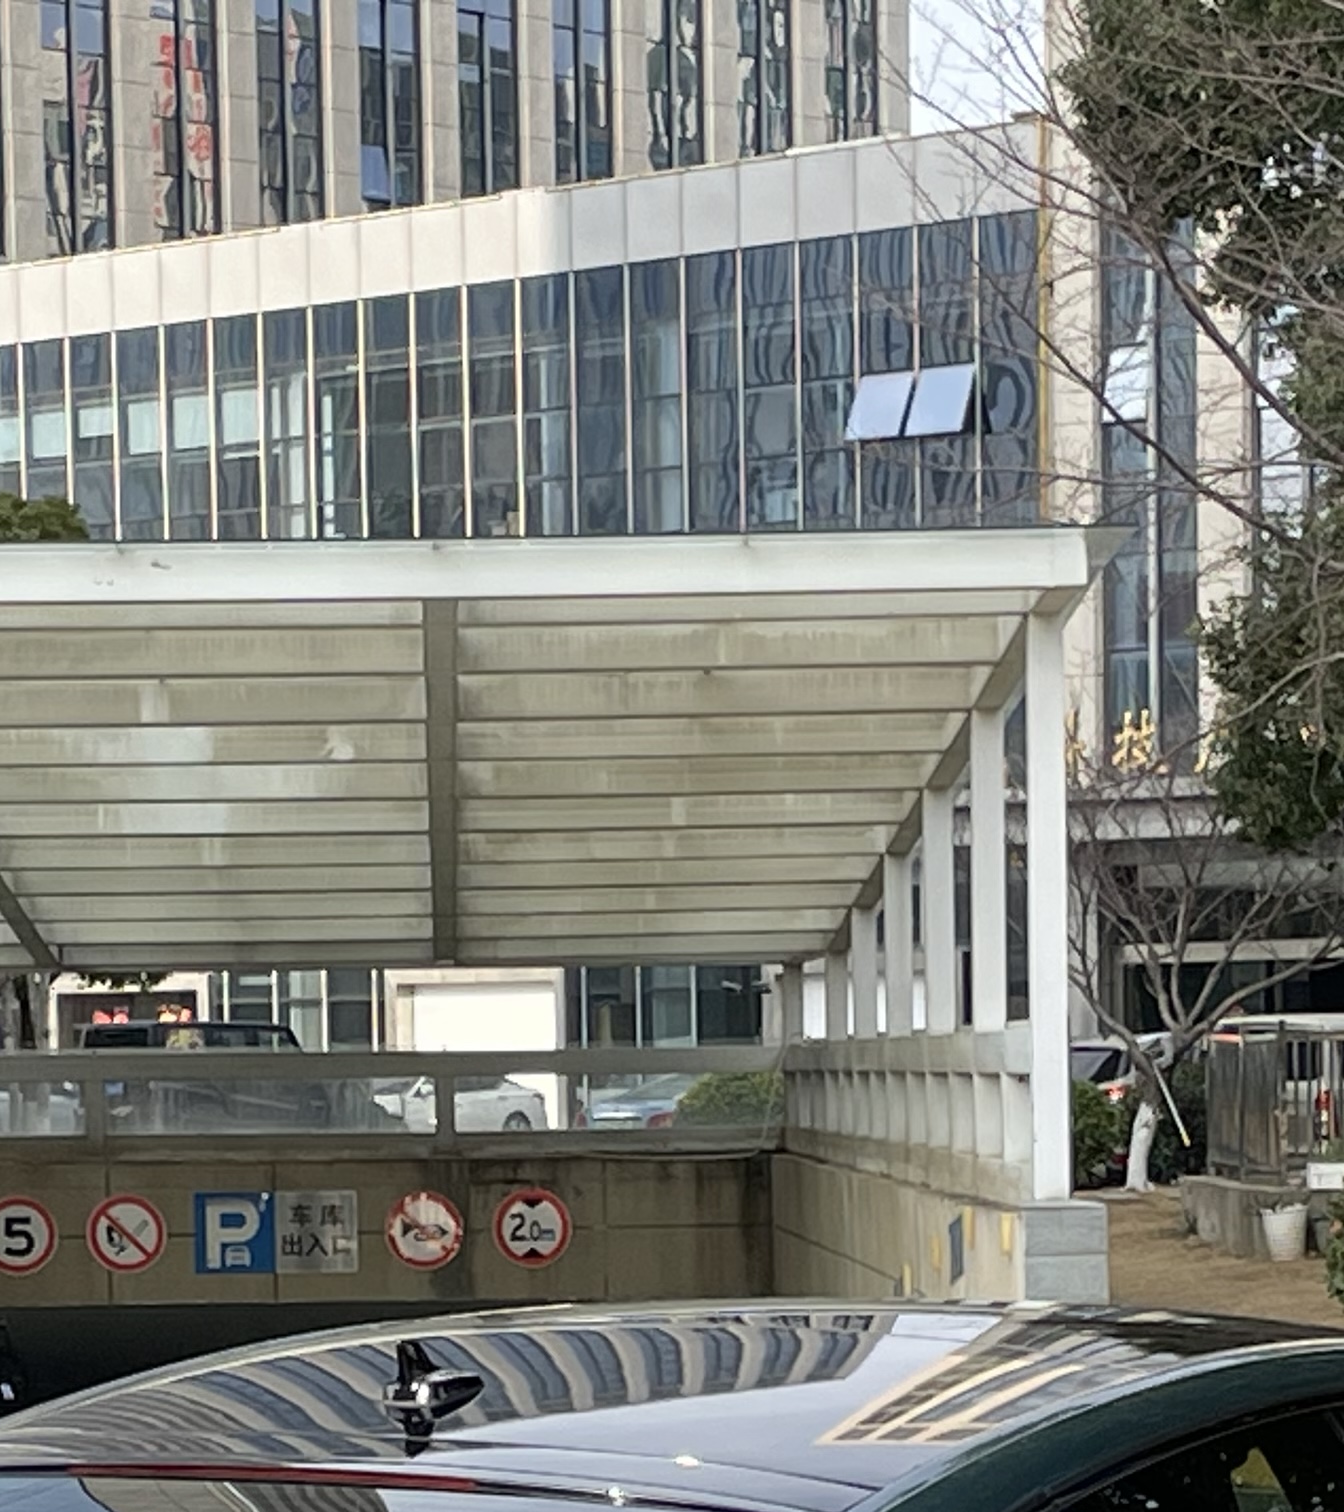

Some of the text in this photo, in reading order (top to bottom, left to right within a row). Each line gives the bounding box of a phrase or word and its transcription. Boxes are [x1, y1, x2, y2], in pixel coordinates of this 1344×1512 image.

[289, 1204, 345, 1227] 车库
[5, 1216, 36, 1256] 5
[207, 1200, 260, 1269] P
[281, 1232, 352, 1257] 出入口
